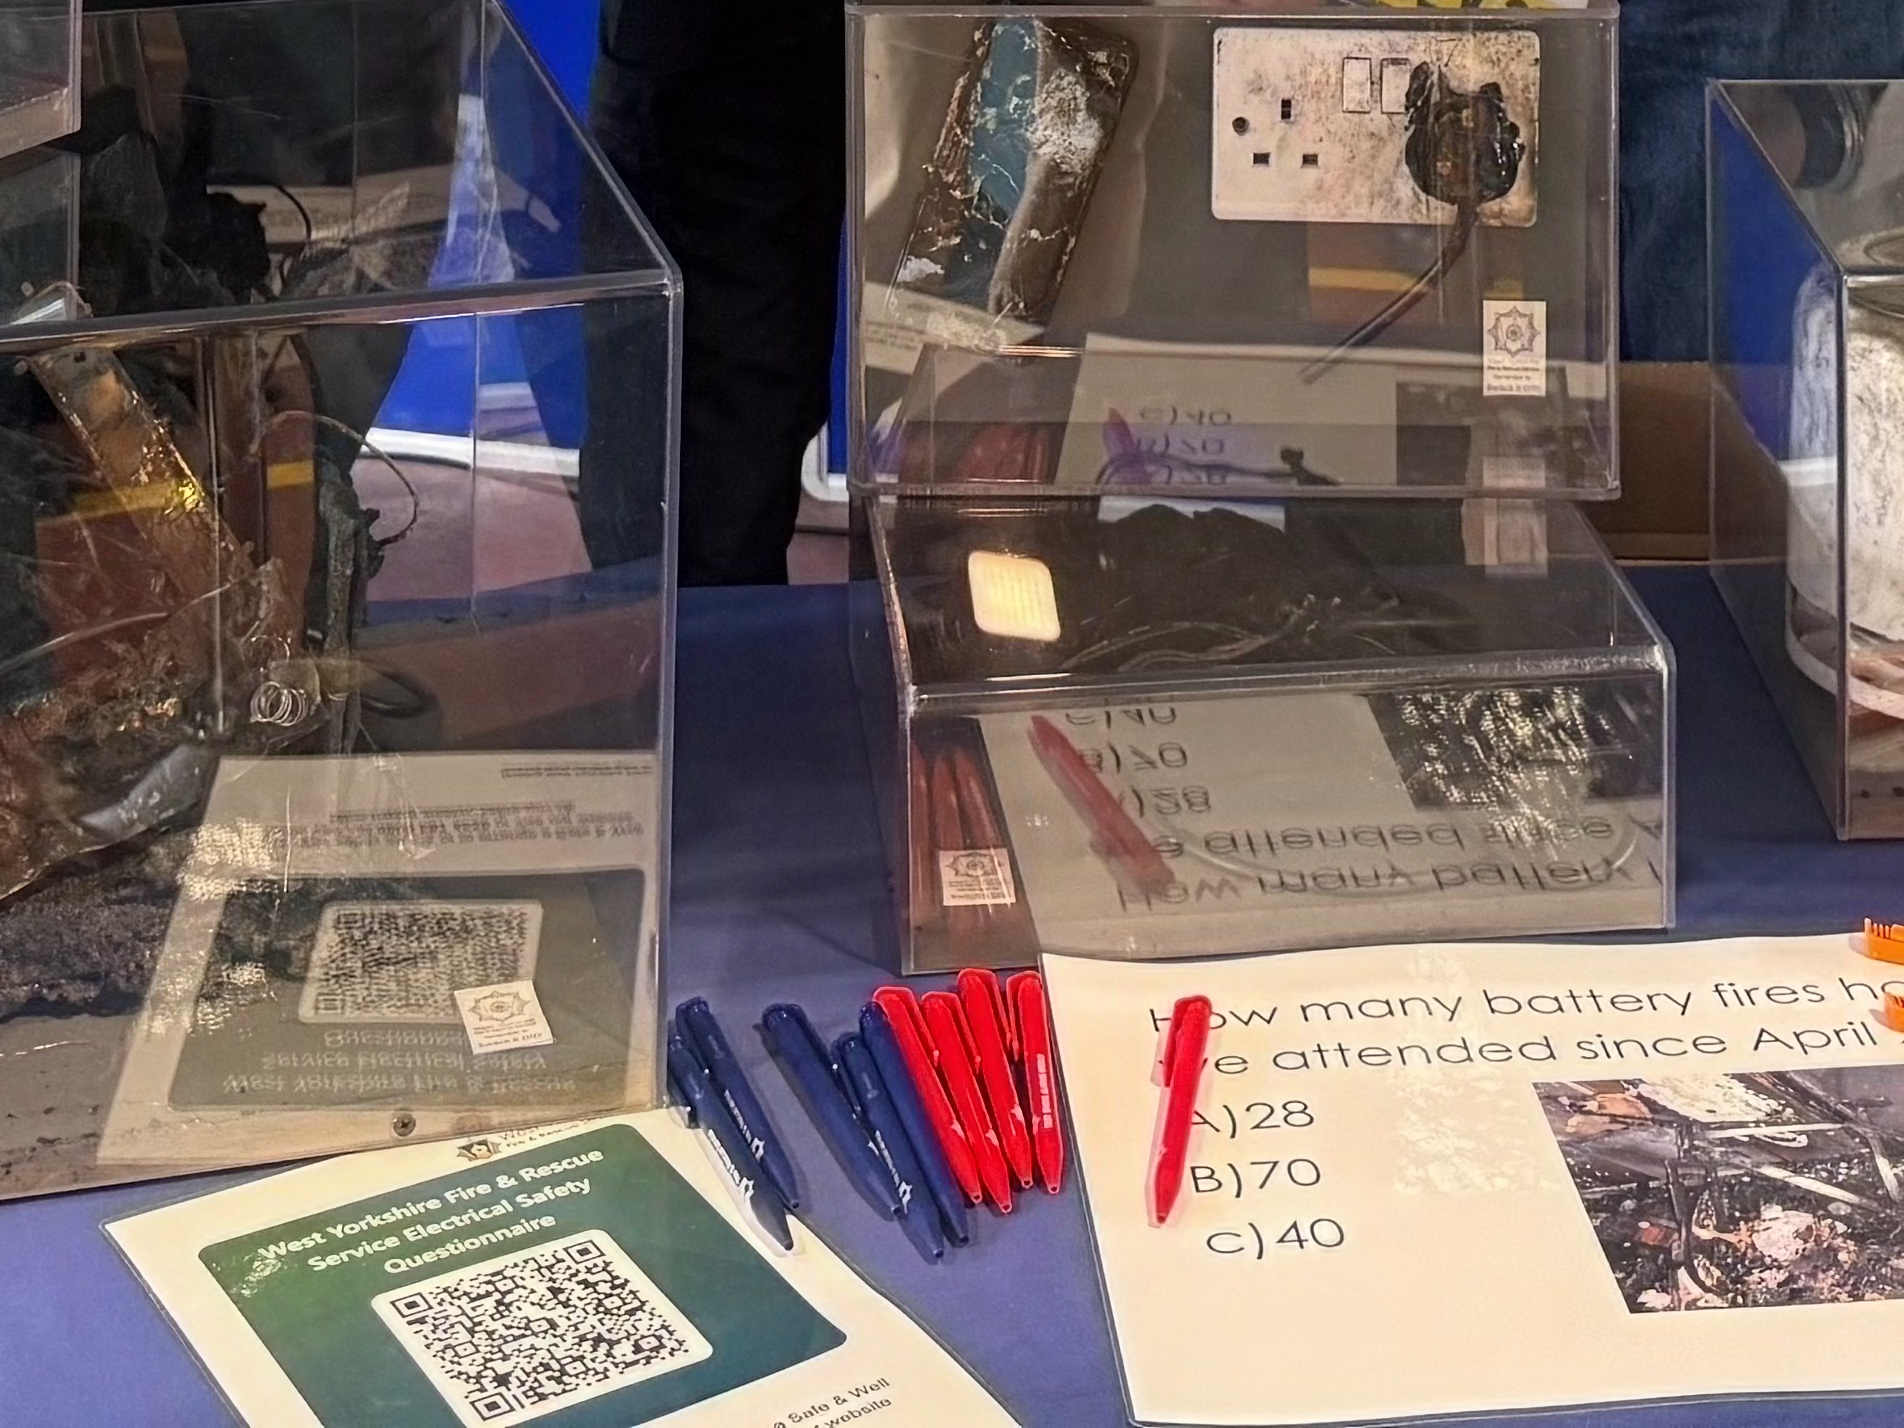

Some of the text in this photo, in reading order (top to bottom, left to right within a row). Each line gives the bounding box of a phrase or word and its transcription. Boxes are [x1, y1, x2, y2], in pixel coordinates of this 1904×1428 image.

[1302, 994, 1463, 1024] many
[1483, 988, 1693, 1017] battery
[1712, 981, 1826, 1008] fires
[1273, 1035, 1558, 1071] attended
[1577, 1032, 1727, 1061] since
[1752, 1020, 1878, 1056] April
[1191, 1158, 1321, 1199] B)70
[258, 1147, 605, 1261] West Yorkshire Fire & Rescue
[308, 1176, 592, 1273] Service Electrical Safety
[383, 1213, 557, 1275] Questionnaire
[787, 1376, 891, 1424] Safe & Well
[825, 1396, 893, 1428] website
